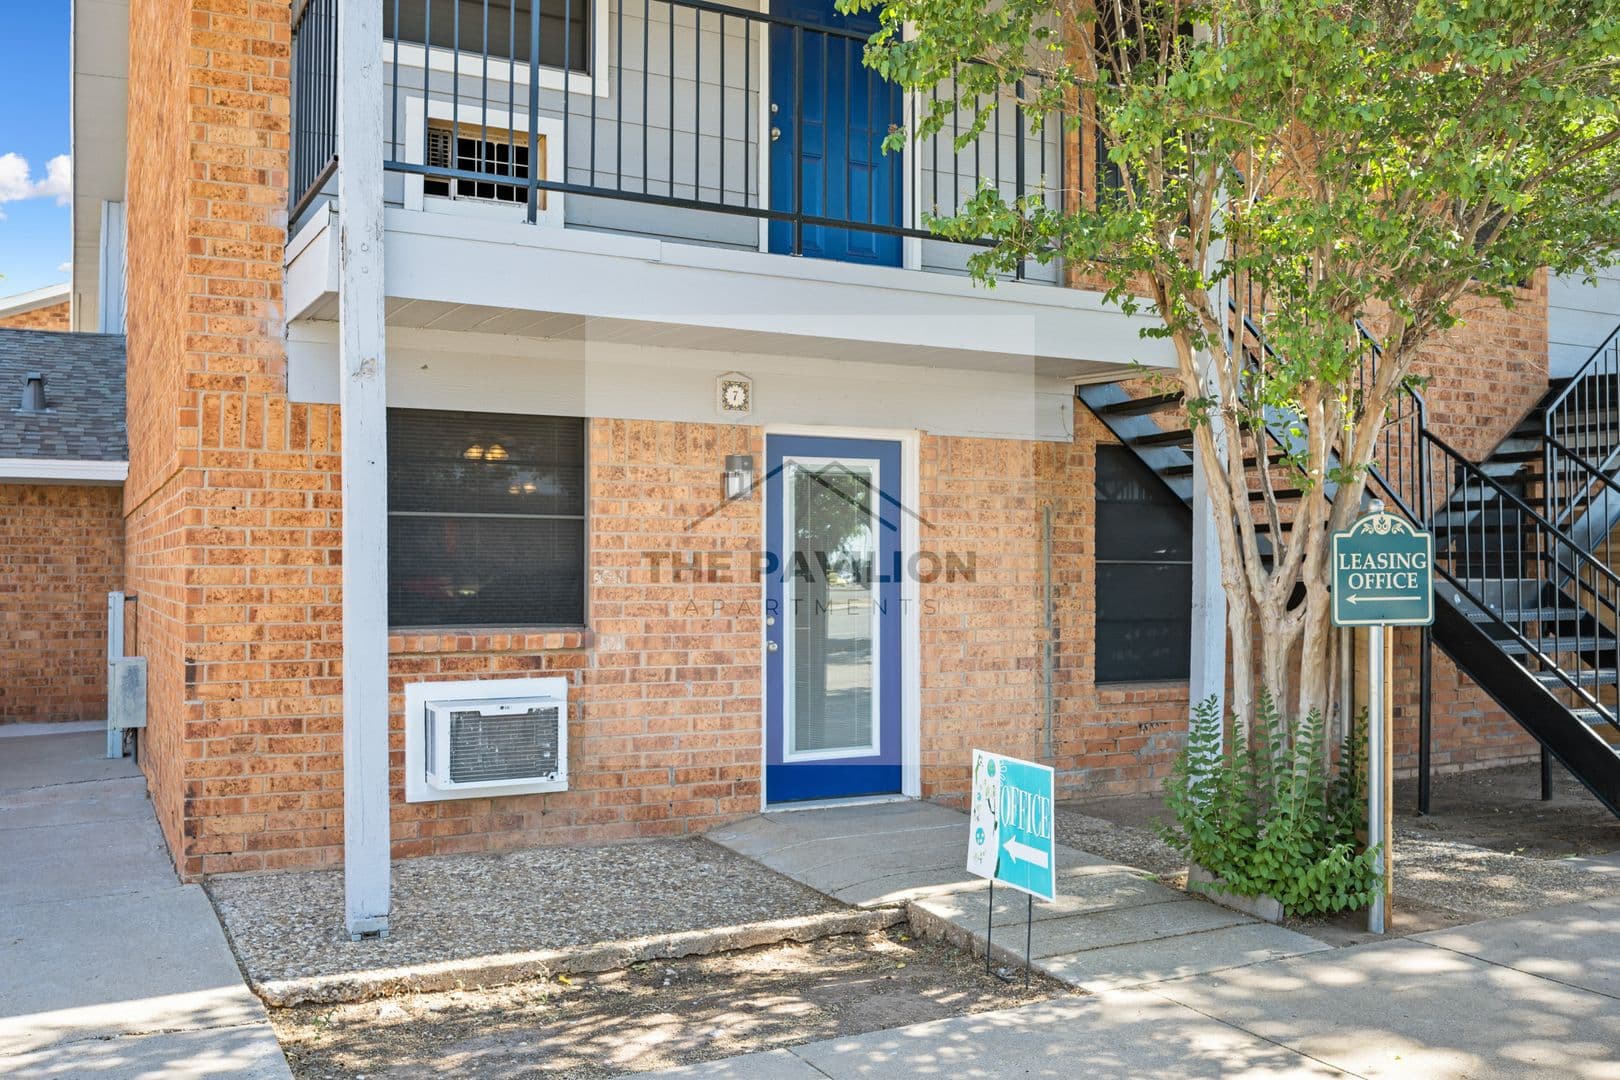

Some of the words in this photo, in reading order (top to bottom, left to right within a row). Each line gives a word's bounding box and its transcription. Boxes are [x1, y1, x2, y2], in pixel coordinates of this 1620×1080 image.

[732, 390, 738, 401] 7
[1339, 552, 1427, 570] LEASING
[1348, 572, 1418, 589] OFFICE
[1001, 785, 1050, 839] OFFICE
